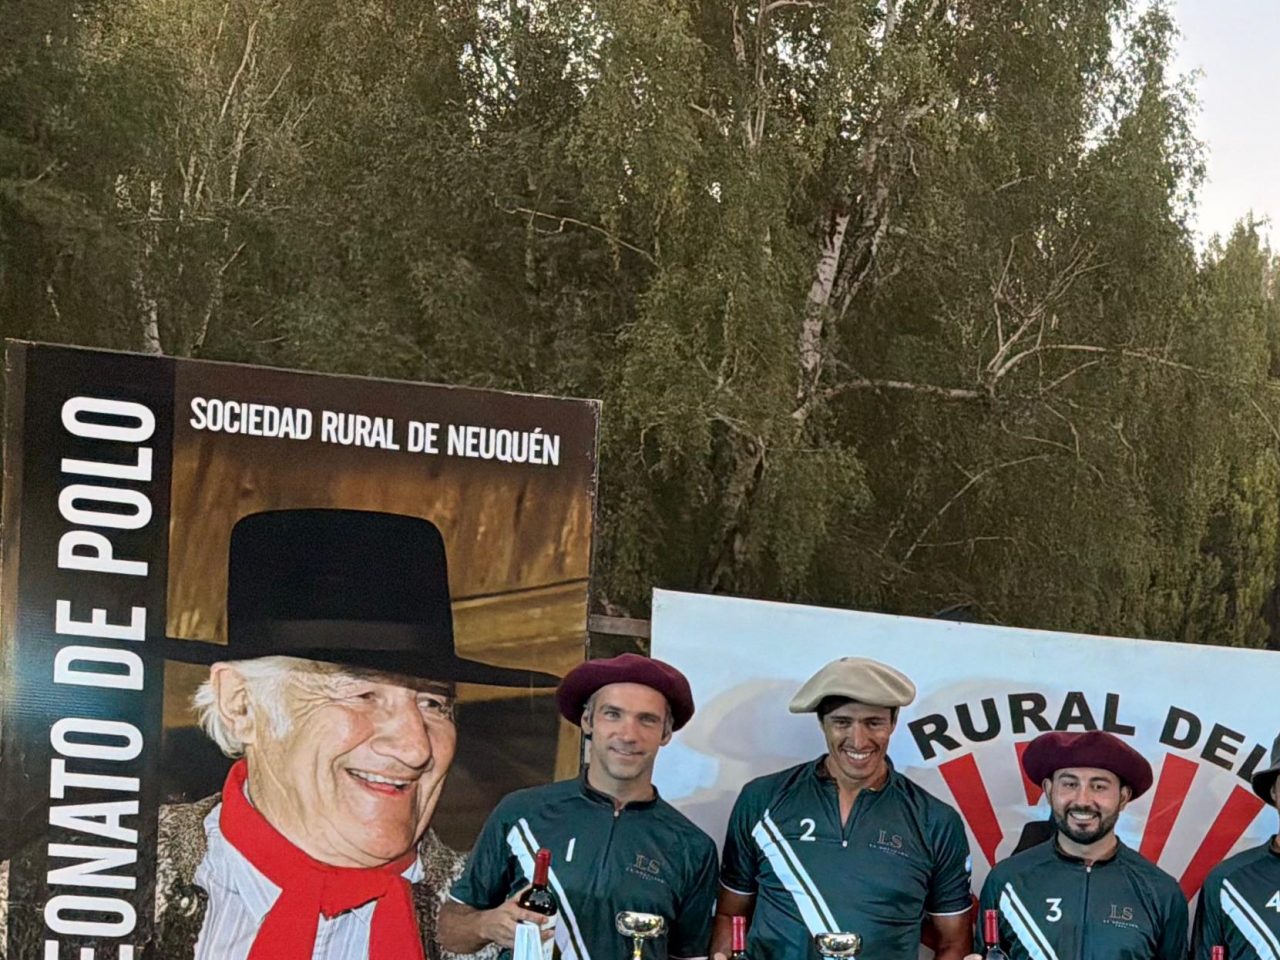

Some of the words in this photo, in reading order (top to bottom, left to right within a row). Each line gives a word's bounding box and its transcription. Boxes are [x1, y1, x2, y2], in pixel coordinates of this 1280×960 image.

[189, 397, 313, 441] SOCIEDAD
[320, 410, 400, 451] RURAL
[407, 420, 439, 455] DE
[446, 424, 561, 467] NEUQUÉN
[57, 396, 156, 577] POLO
[53, 600, 147, 691] DE
[908, 691, 1136, 761] RURAL
[799, 818, 816, 842] 2
[1045, 897, 1063, 923] 3
